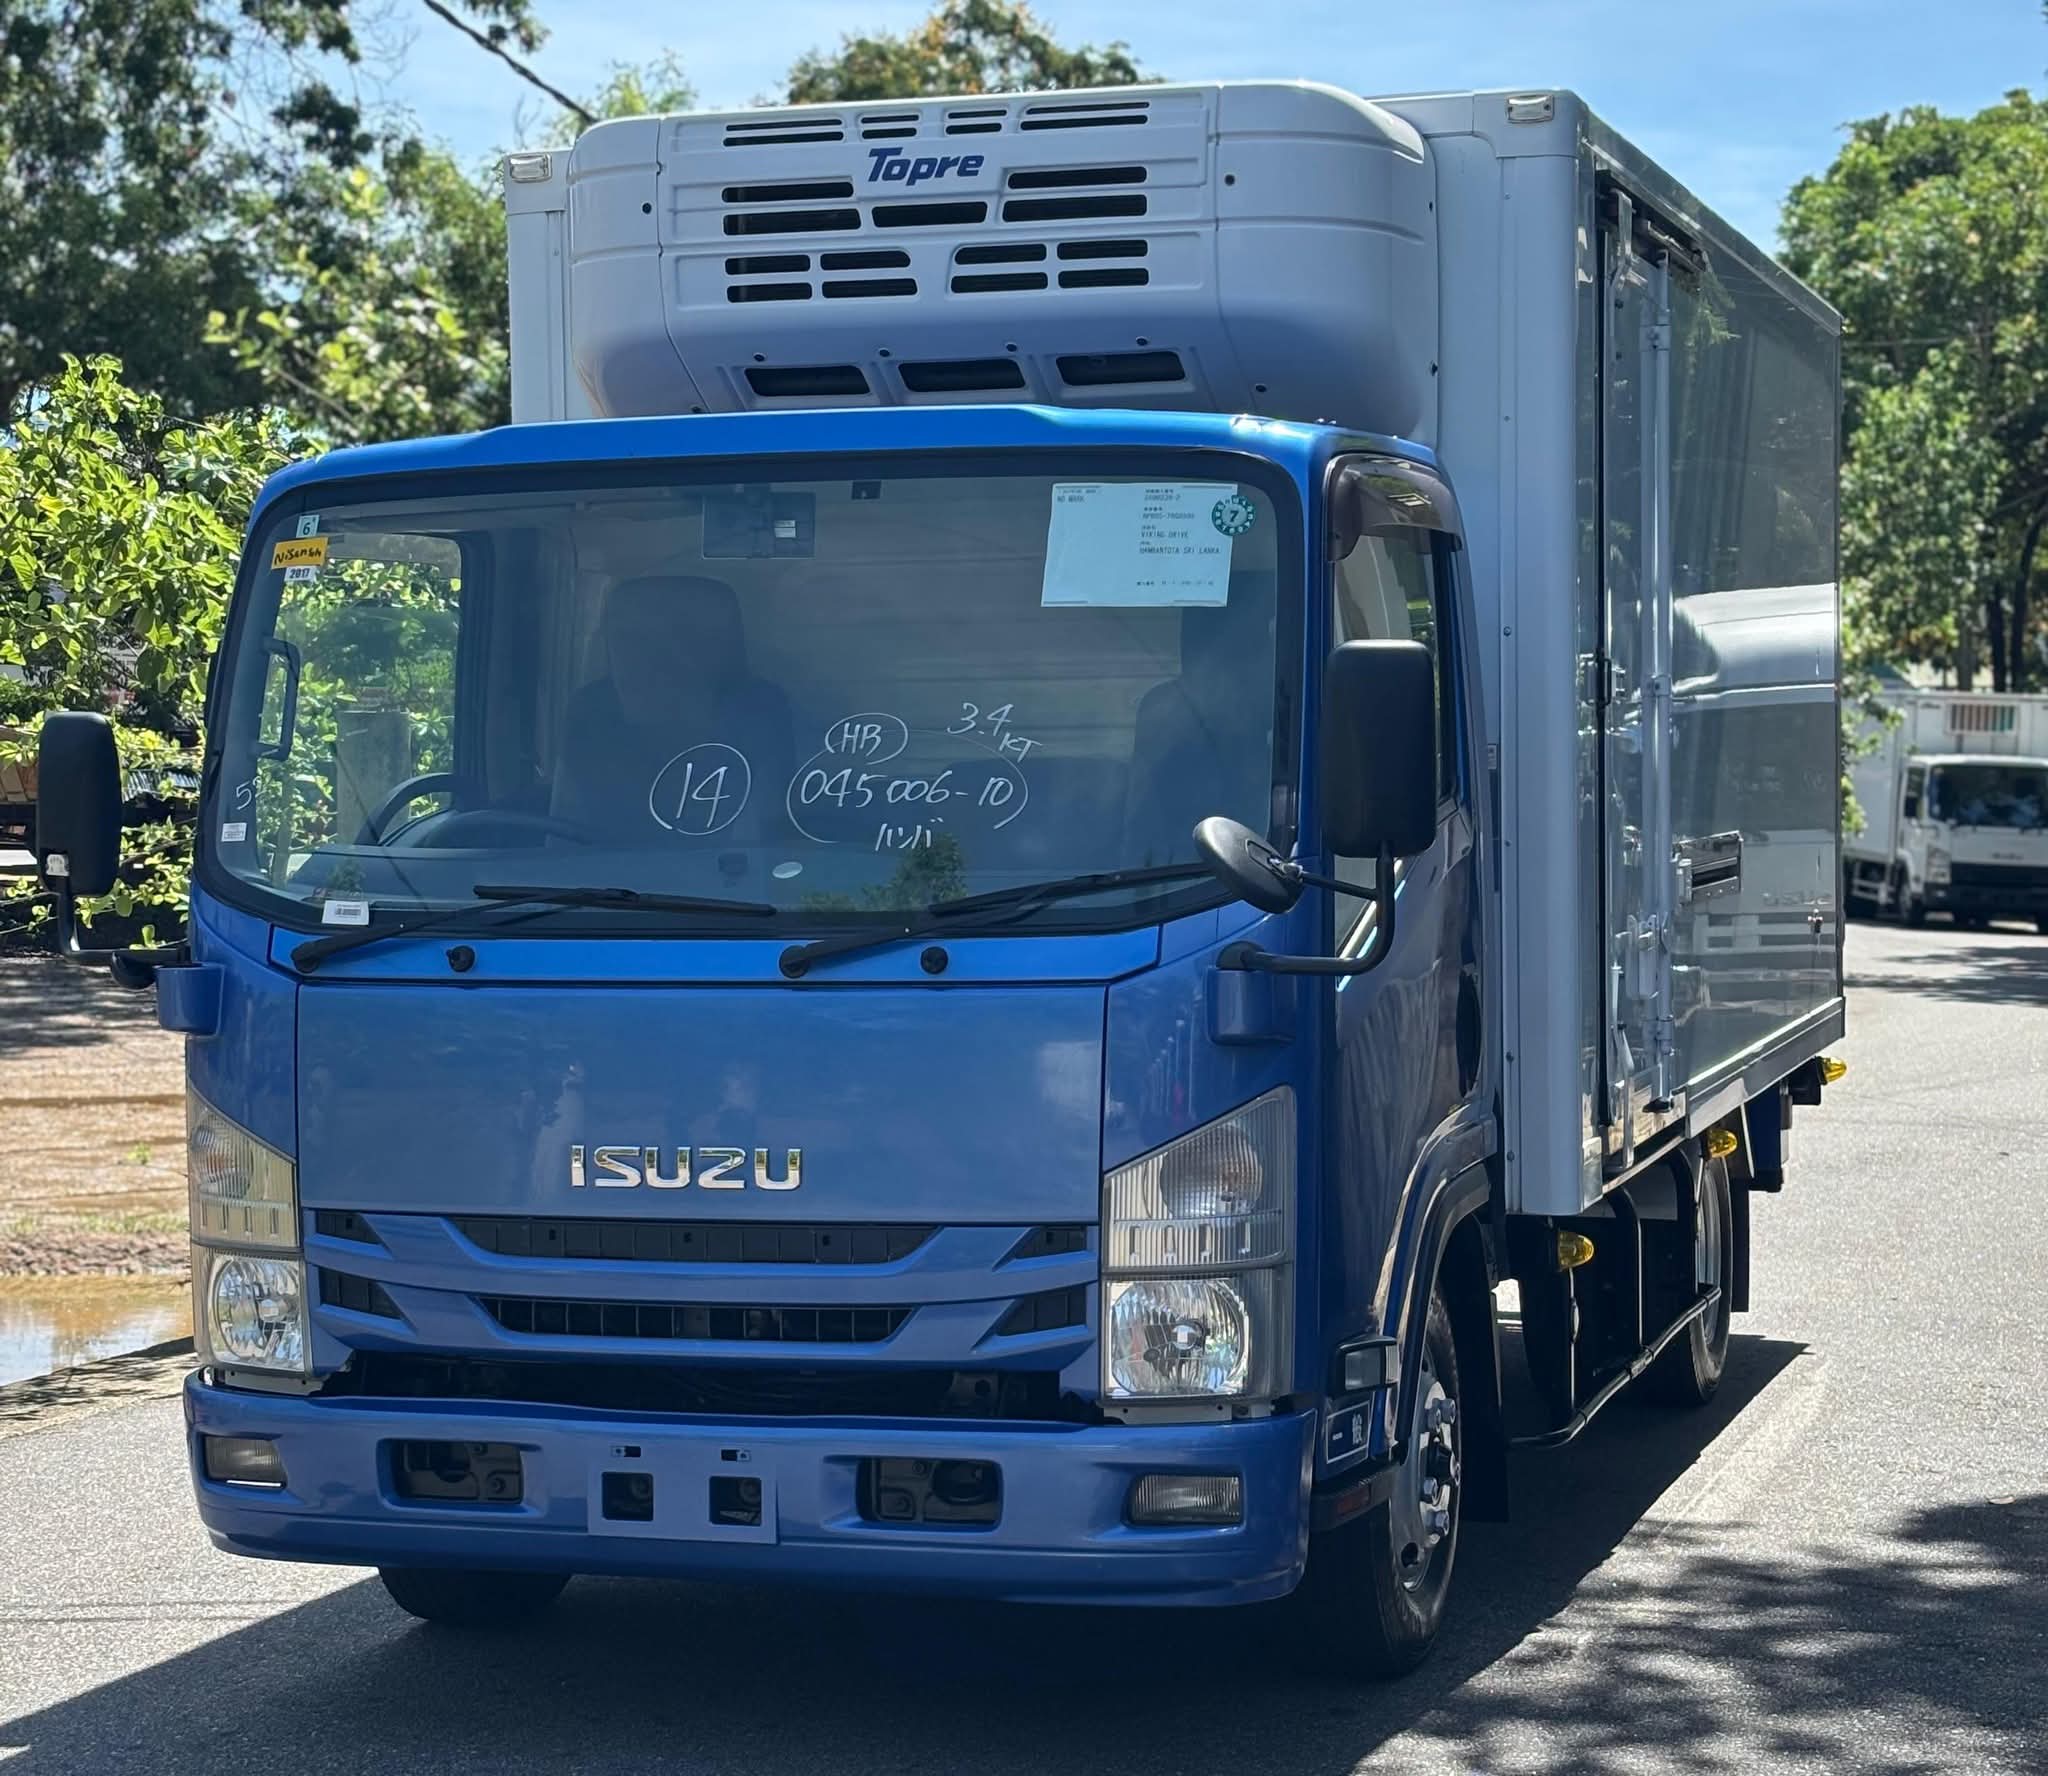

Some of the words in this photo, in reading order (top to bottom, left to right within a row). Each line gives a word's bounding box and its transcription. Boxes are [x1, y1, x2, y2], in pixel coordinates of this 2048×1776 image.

[868, 147, 984, 186] Topre
[1230, 510, 1239, 522] 7
[302, 523, 310, 535] 6
[1199, 546, 1220, 554] LANKA
[290, 568, 310, 579] 2017
[947, 702, 1014, 736] 3.4
[676, 763, 731, 828] 14
[571, 1145, 802, 1190] ISUZU
